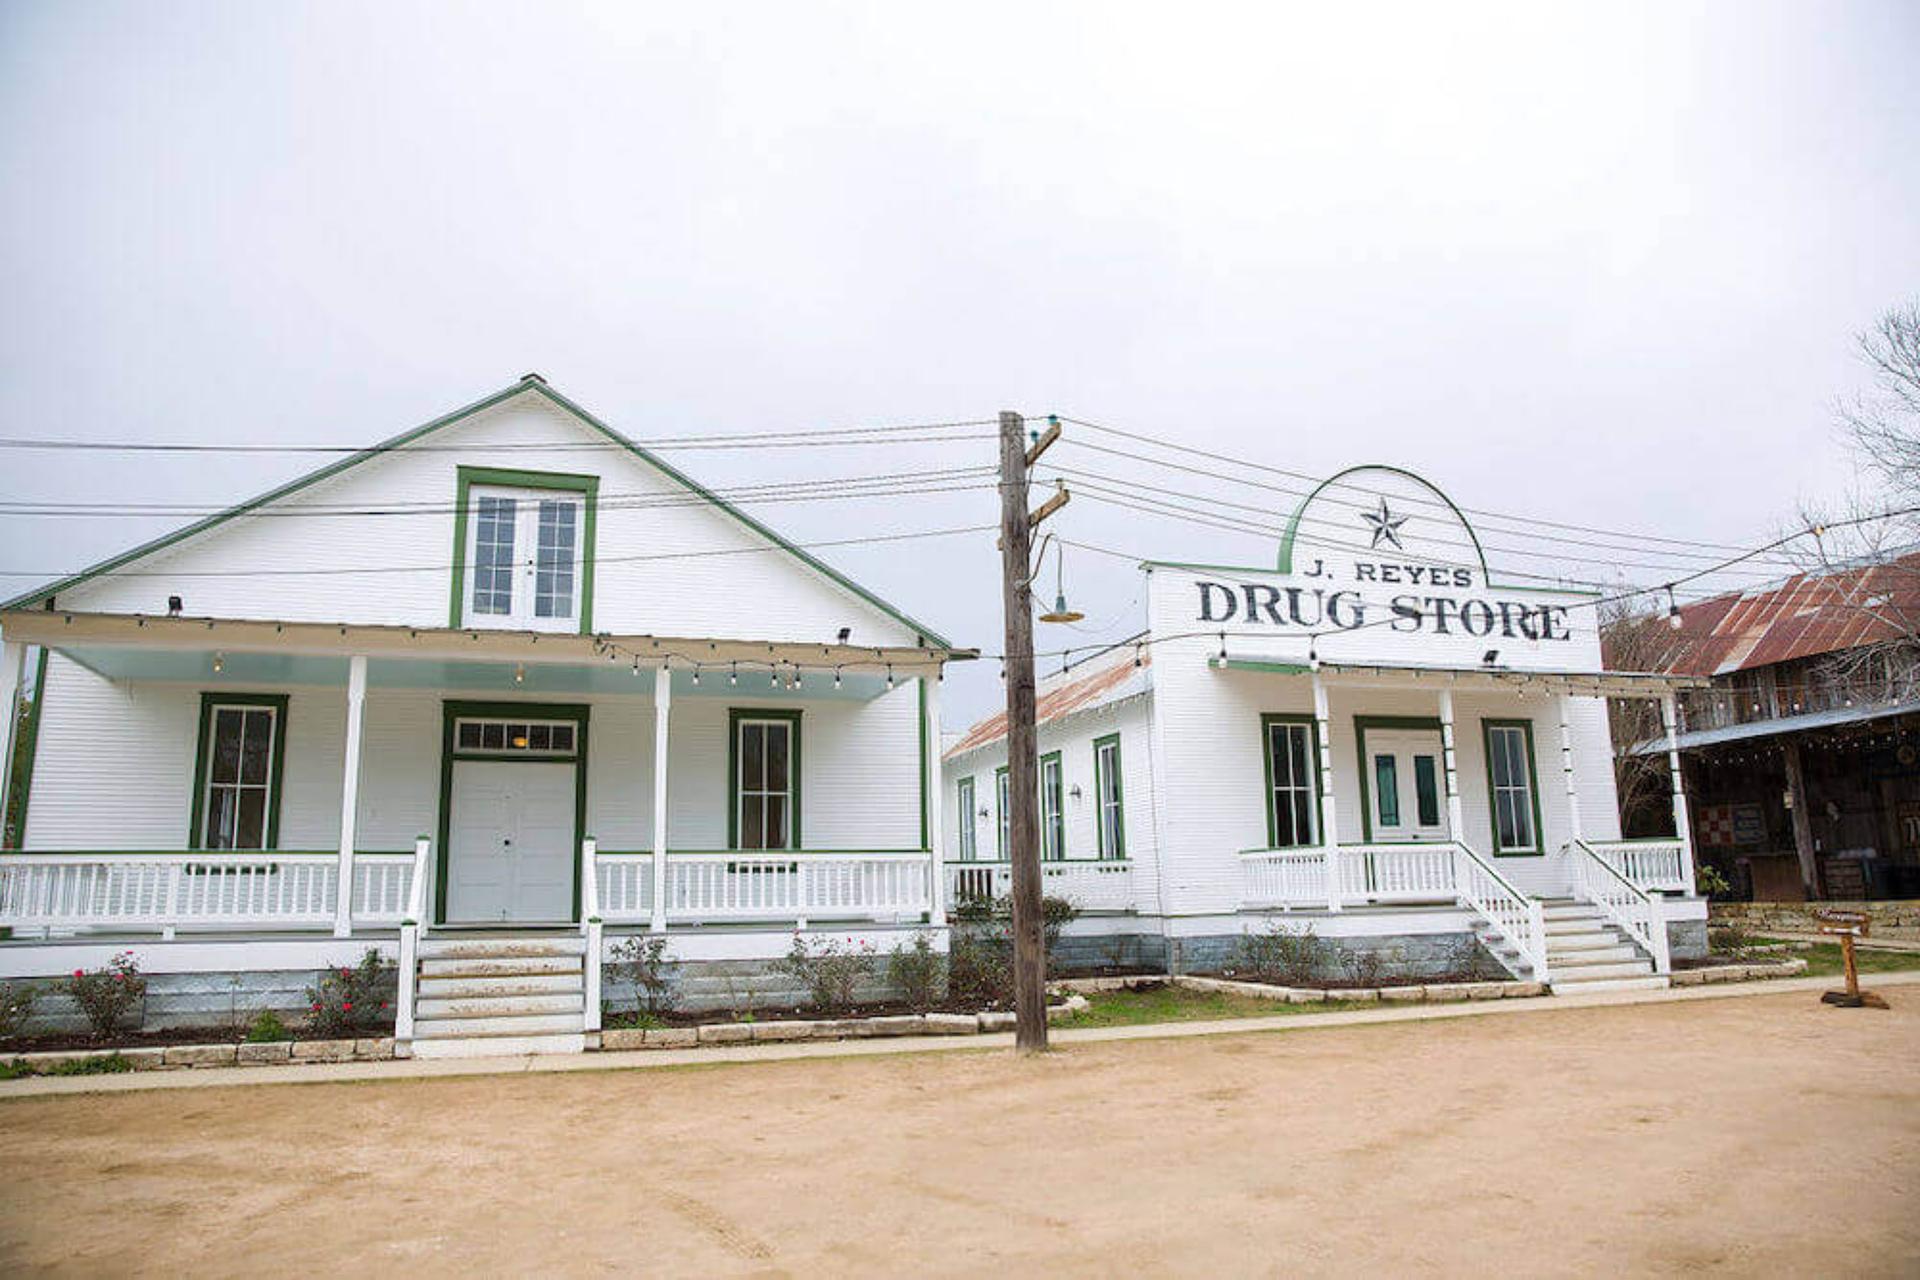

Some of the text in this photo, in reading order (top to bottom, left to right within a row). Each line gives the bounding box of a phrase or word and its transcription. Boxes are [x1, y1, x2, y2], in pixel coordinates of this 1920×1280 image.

[1304, 559, 1473, 587] J. REYES
[1197, 581, 1571, 642] DRUG STORE
